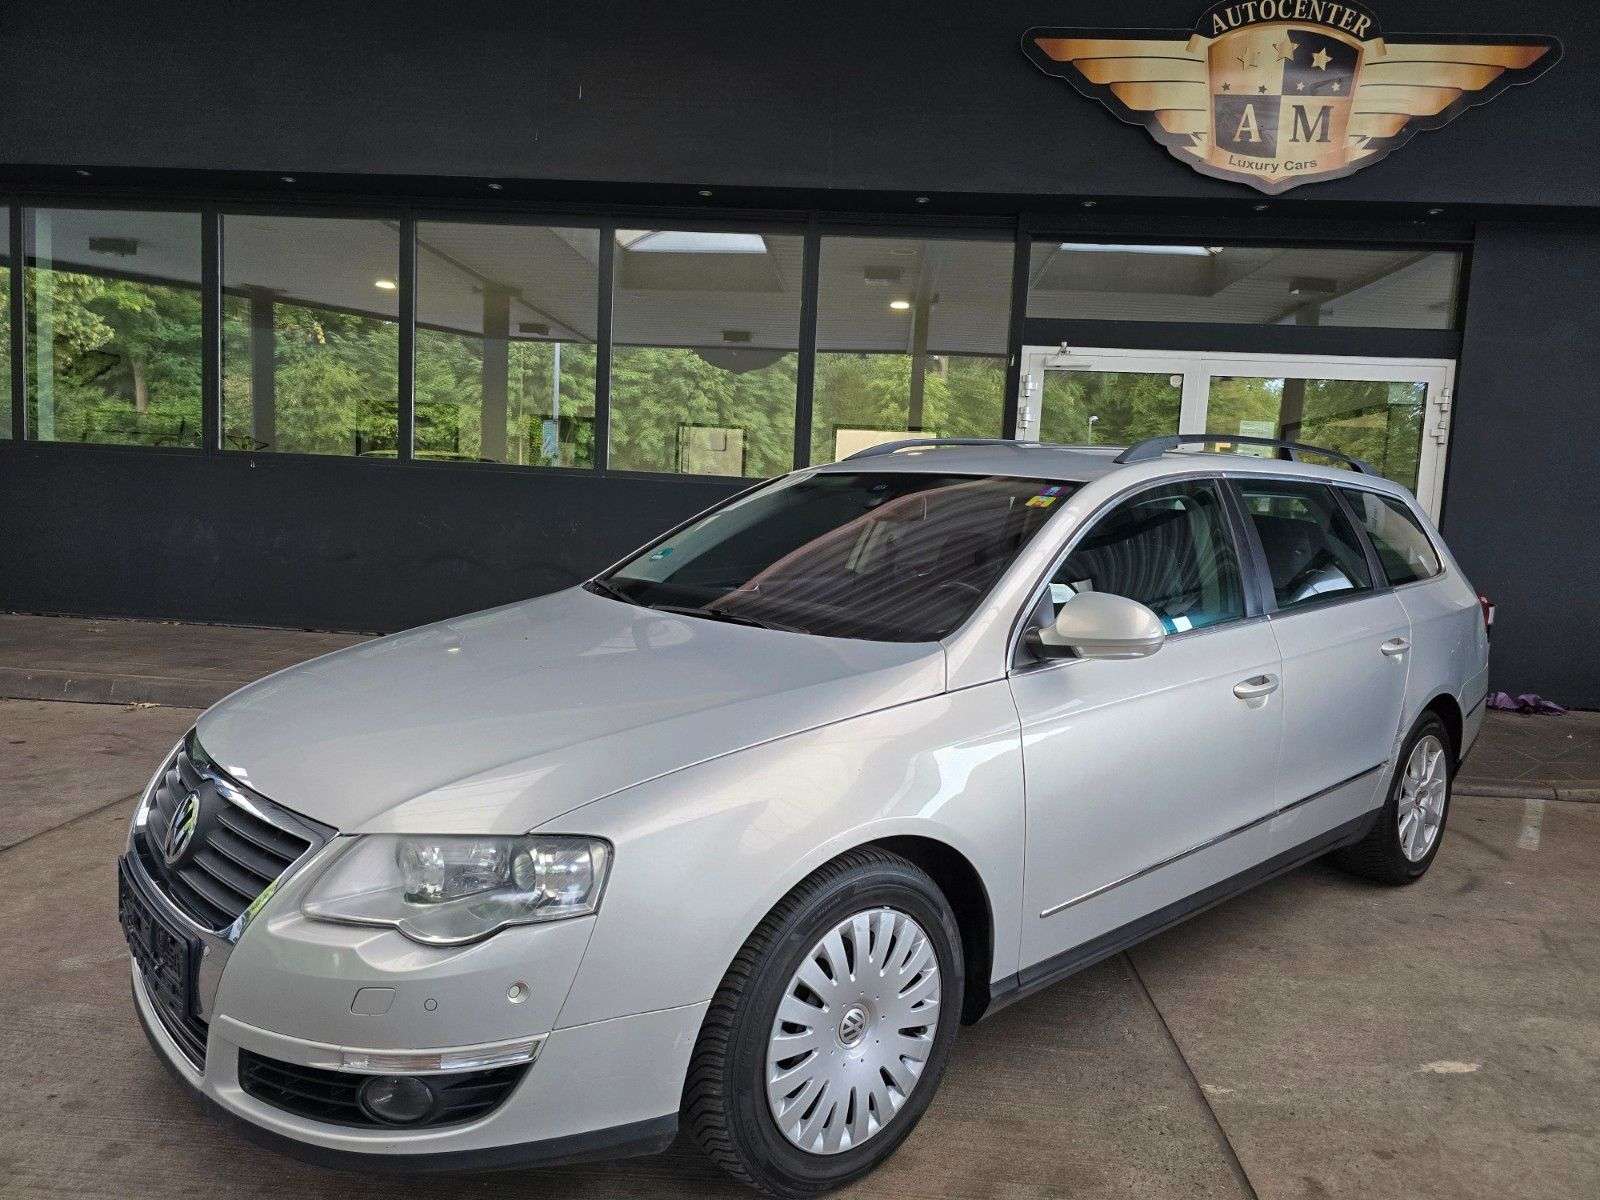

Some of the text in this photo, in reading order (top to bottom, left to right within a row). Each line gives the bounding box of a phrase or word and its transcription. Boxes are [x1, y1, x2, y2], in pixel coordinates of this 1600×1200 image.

[1212, 0, 1371, 38] AUTOCENTER
[1232, 103, 1334, 142] A M
[1228, 155, 1318, 173] Luxury Cars
